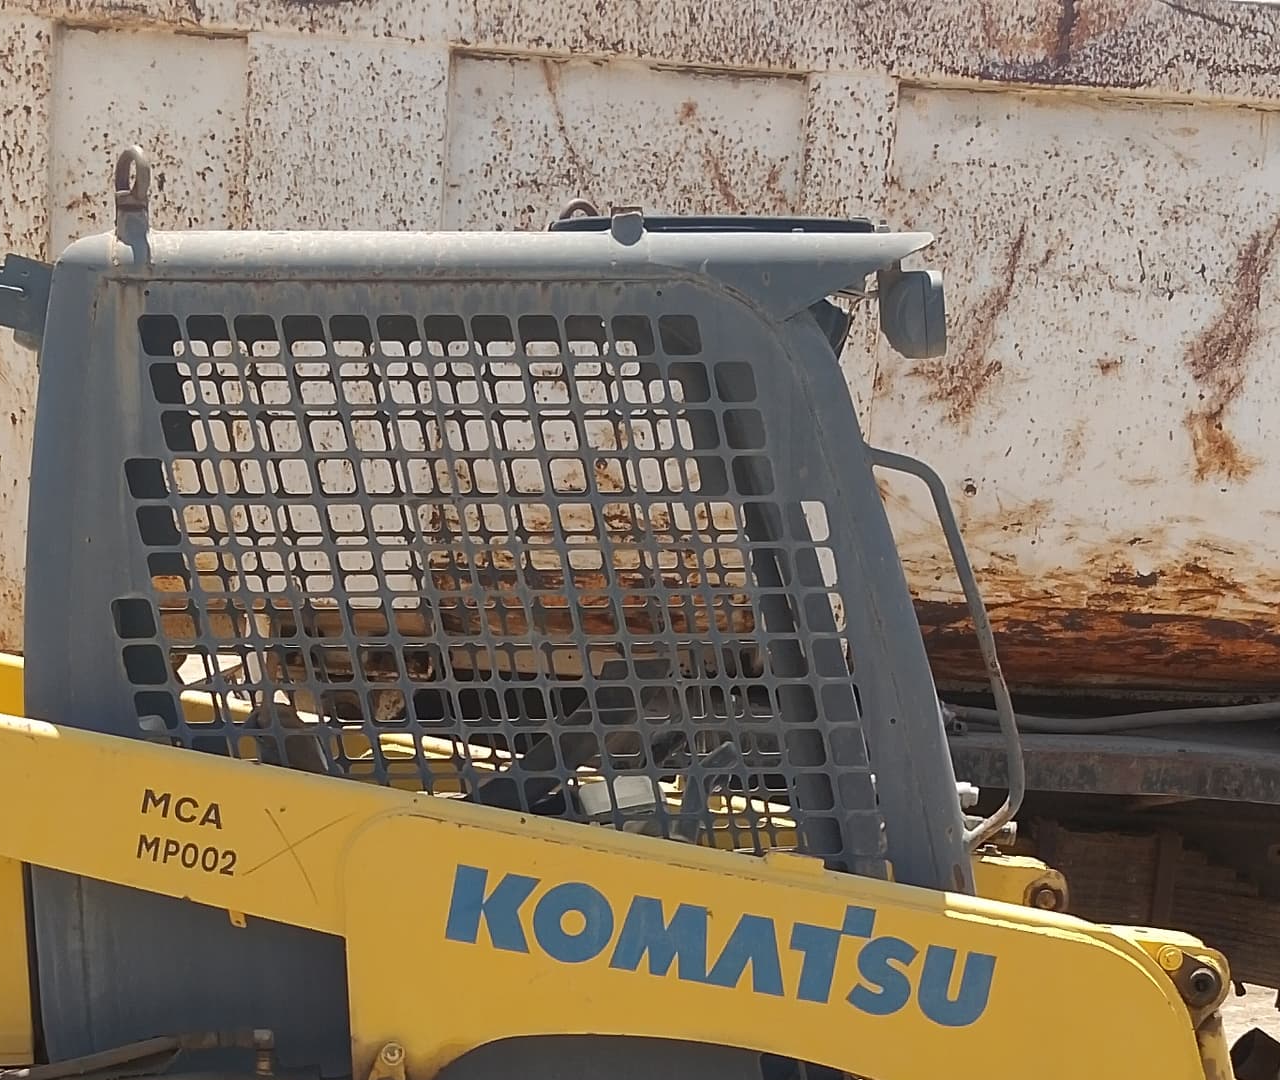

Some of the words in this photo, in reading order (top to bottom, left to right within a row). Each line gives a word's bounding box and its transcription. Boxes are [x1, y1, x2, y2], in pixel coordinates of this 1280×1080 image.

[141, 788, 223, 830] MCA
[136, 834, 237, 876] MP002
[444, 863, 997, 1028] KOMATSU
